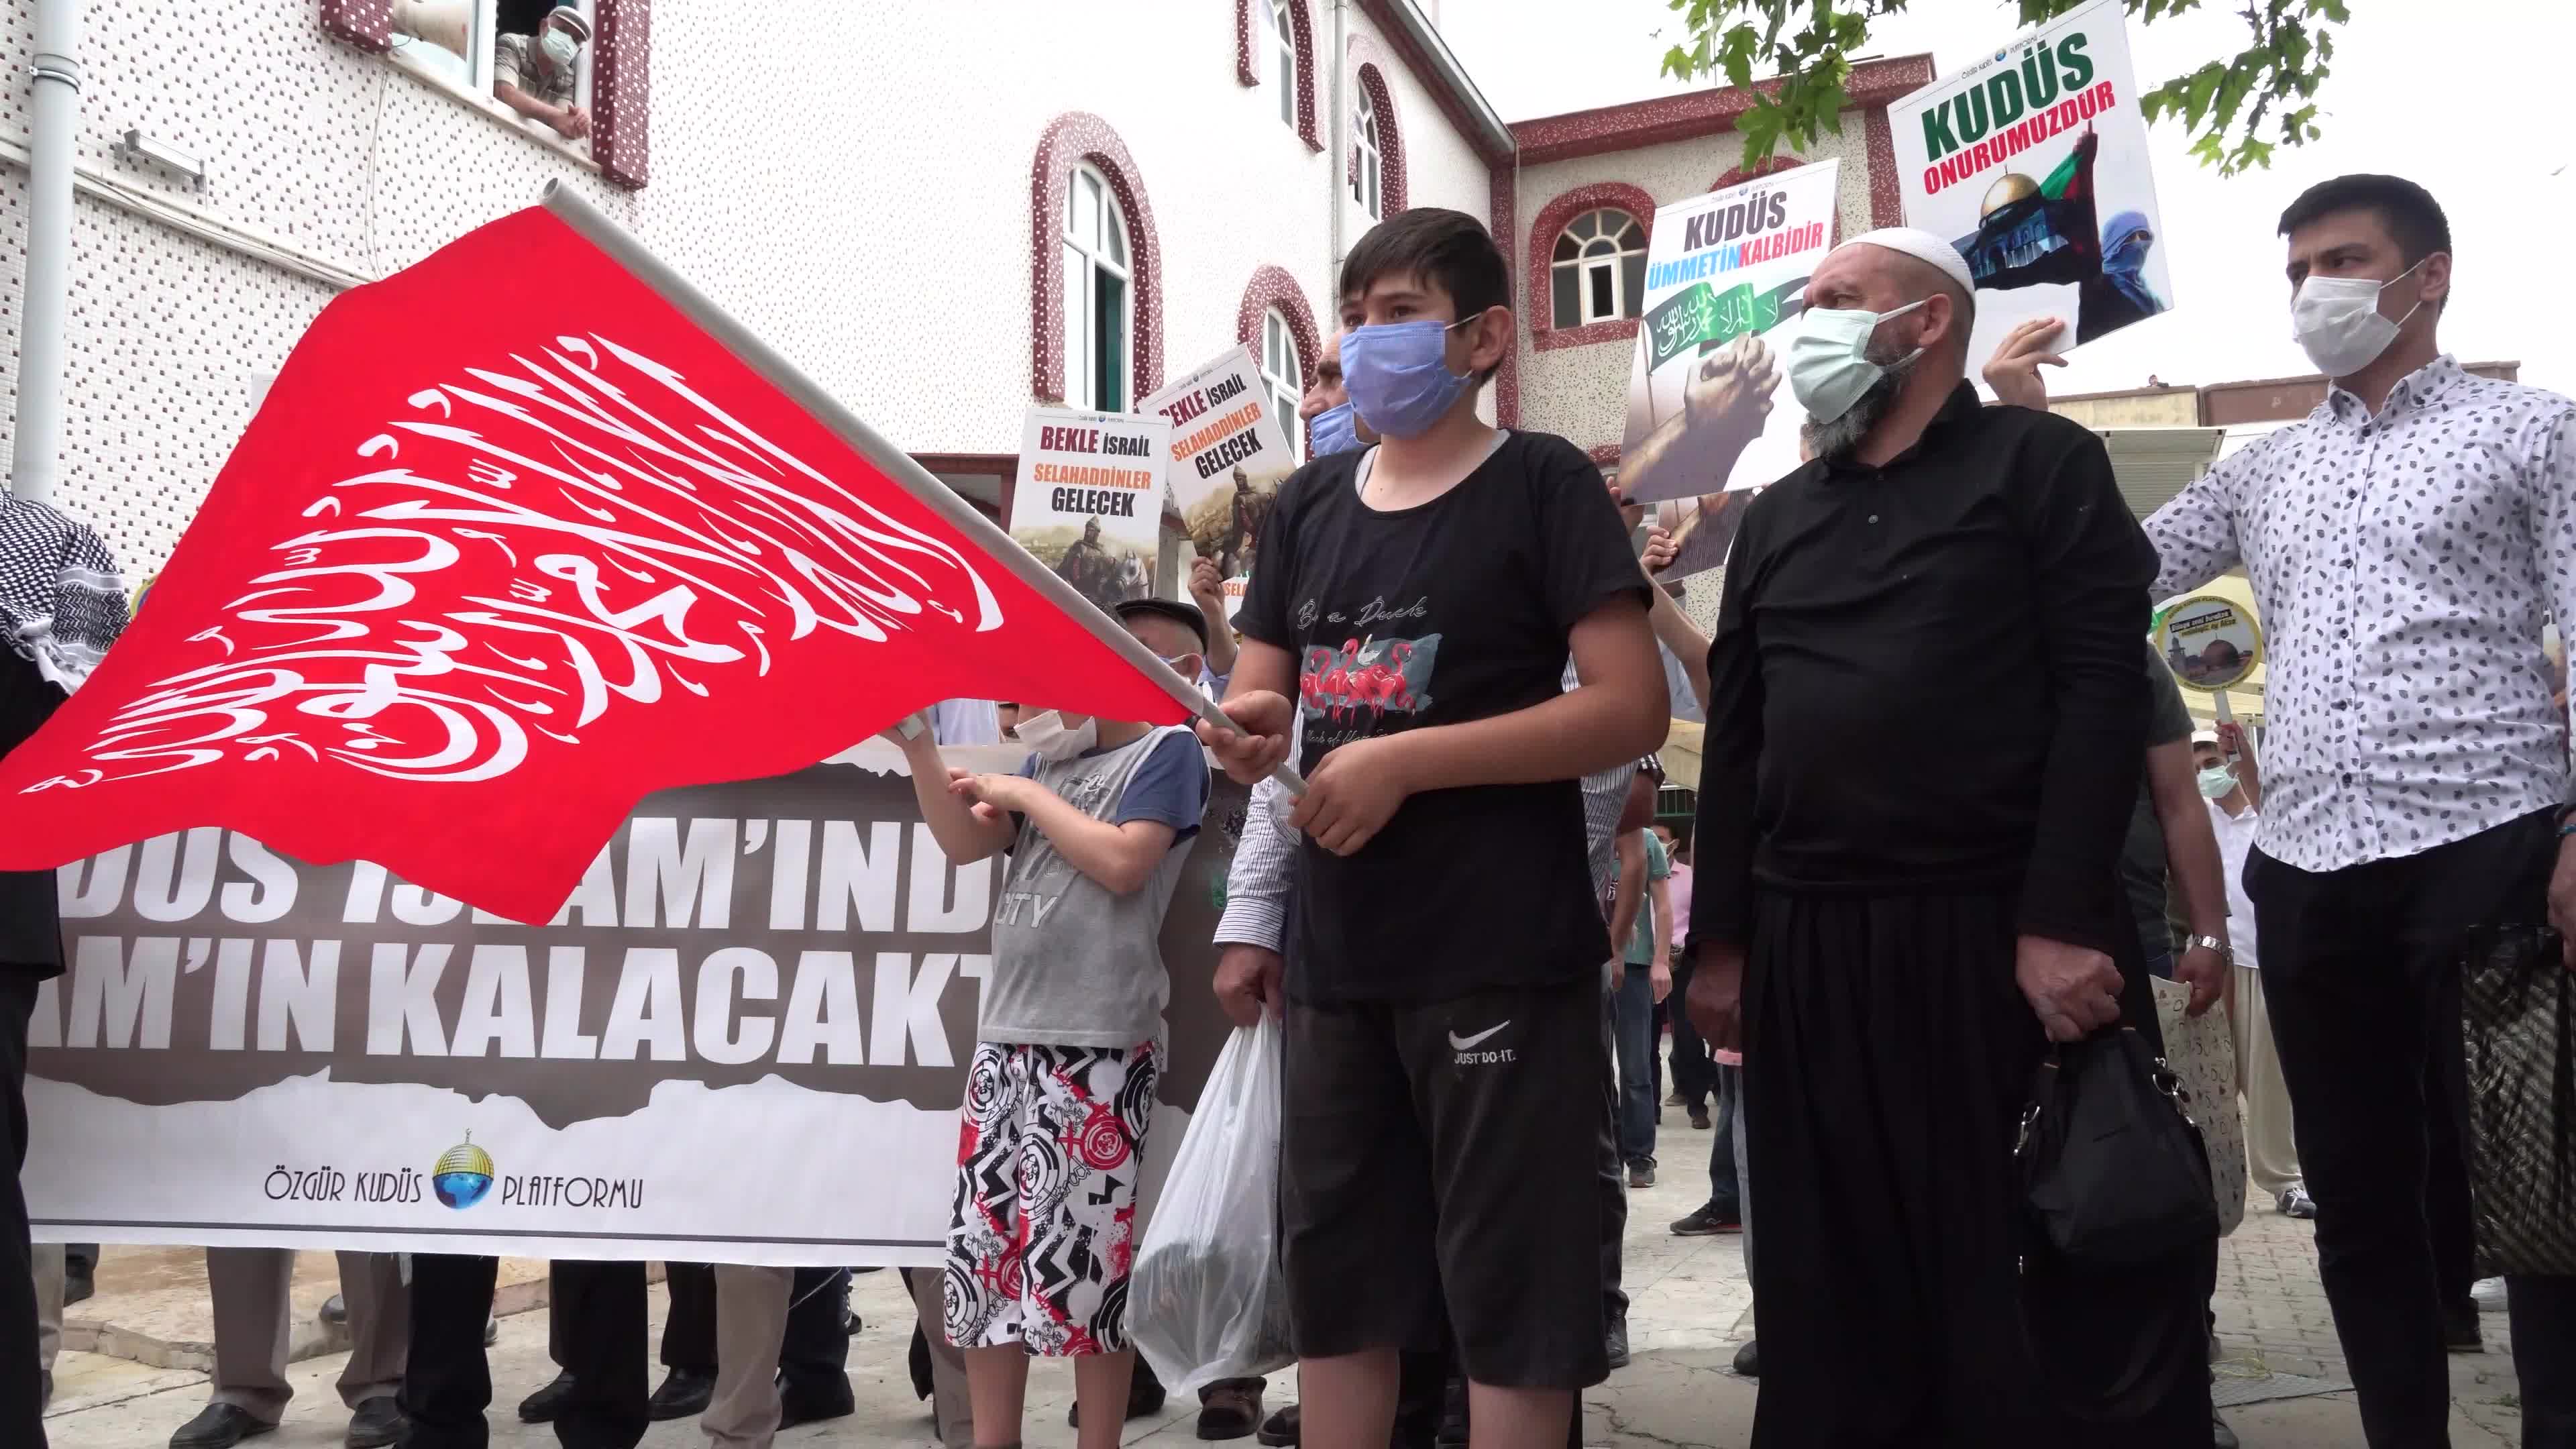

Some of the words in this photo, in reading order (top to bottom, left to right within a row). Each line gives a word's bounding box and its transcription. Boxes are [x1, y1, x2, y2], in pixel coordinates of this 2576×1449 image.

[1921, 32, 2094, 163] KUDÜS
[1923, 80, 2116, 196] ONURUMUZDUR
[1684, 191, 1787, 252] KUDÜS
[1205, 373, 1246, 408] İSRAİL
[1040, 426, 1099, 453] BEKLE
[1103, 432, 1150, 457] İSRAİL
[1171, 402, 1261, 462] SELAHADDİNLER
[1195, 427, 1263, 479] GELECEK
[1034, 462, 1151, 490] SELAHADDİNLER
[1051, 487, 1135, 517] GELECEK
[1354, 596, 1428, 627] Duck
[1454, 1053, 1480, 1065] JUST
[1483, 1051, 1497, 1063] DO
[265, 1165, 345, 1202] ÖZGÜR
[354, 1167, 422, 1203] KUDÜS
[502, 1175, 643, 1208] PLATFORMU
